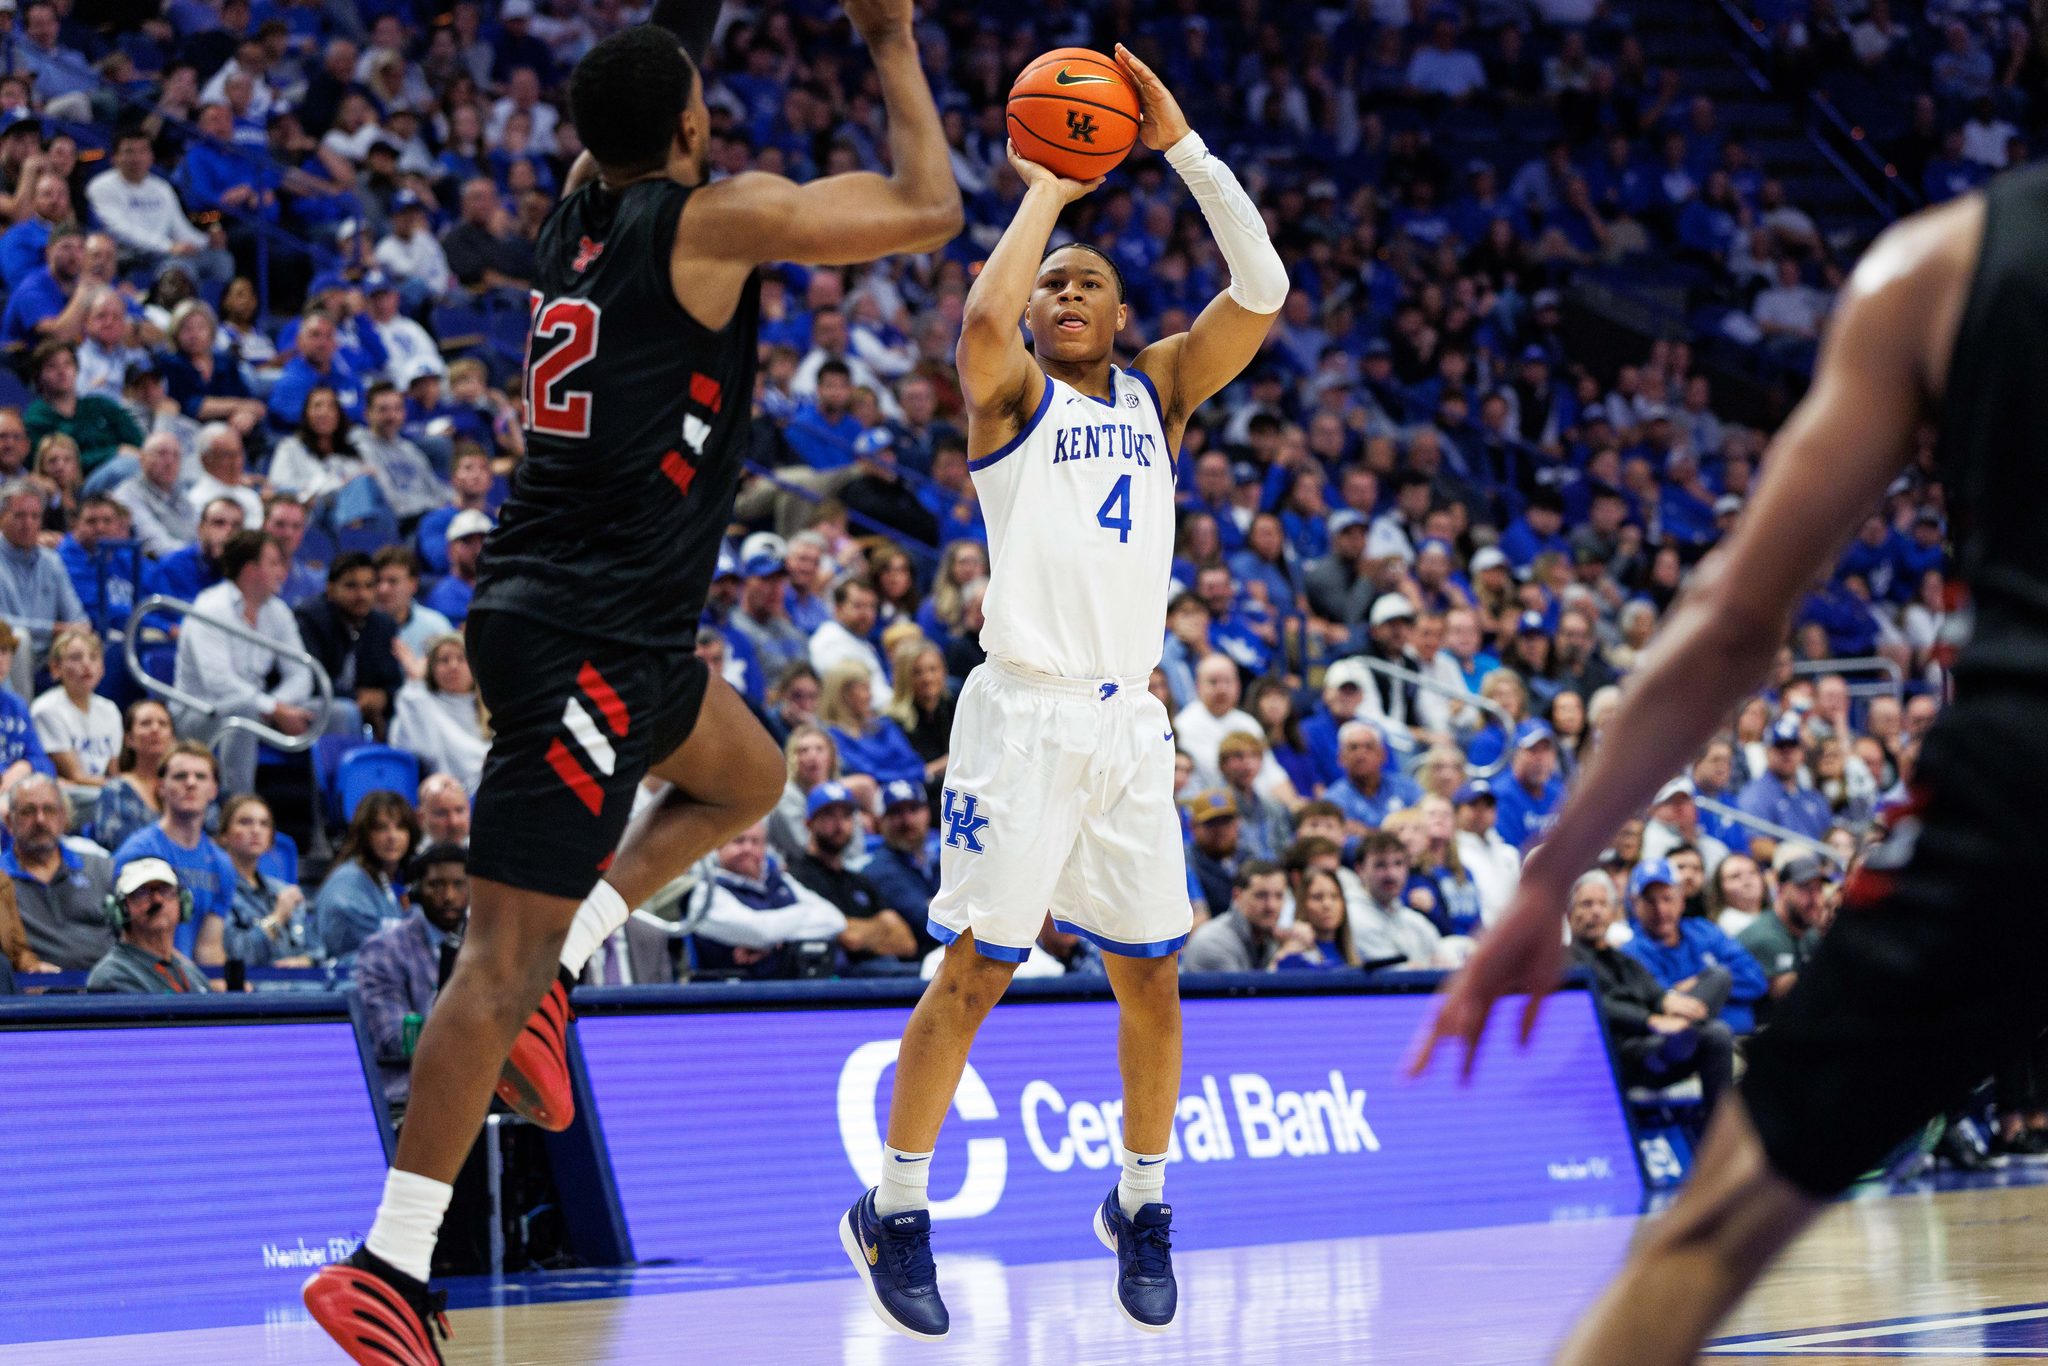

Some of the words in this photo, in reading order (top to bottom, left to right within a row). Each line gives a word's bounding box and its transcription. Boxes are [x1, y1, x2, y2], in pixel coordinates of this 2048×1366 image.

[1066, 109, 1099, 144] UK
[521, 289, 601, 438] 2
[1053, 424, 1156, 466] KENTUK
[1096, 474, 1132, 543] 4
[942, 787, 989, 855] UK
[1020, 1075, 1235, 1172] Cenal
[1229, 1070, 1380, 1158] Bank
[262, 1237, 327, 1269] Member
[327, 1236, 363, 1262] FD
